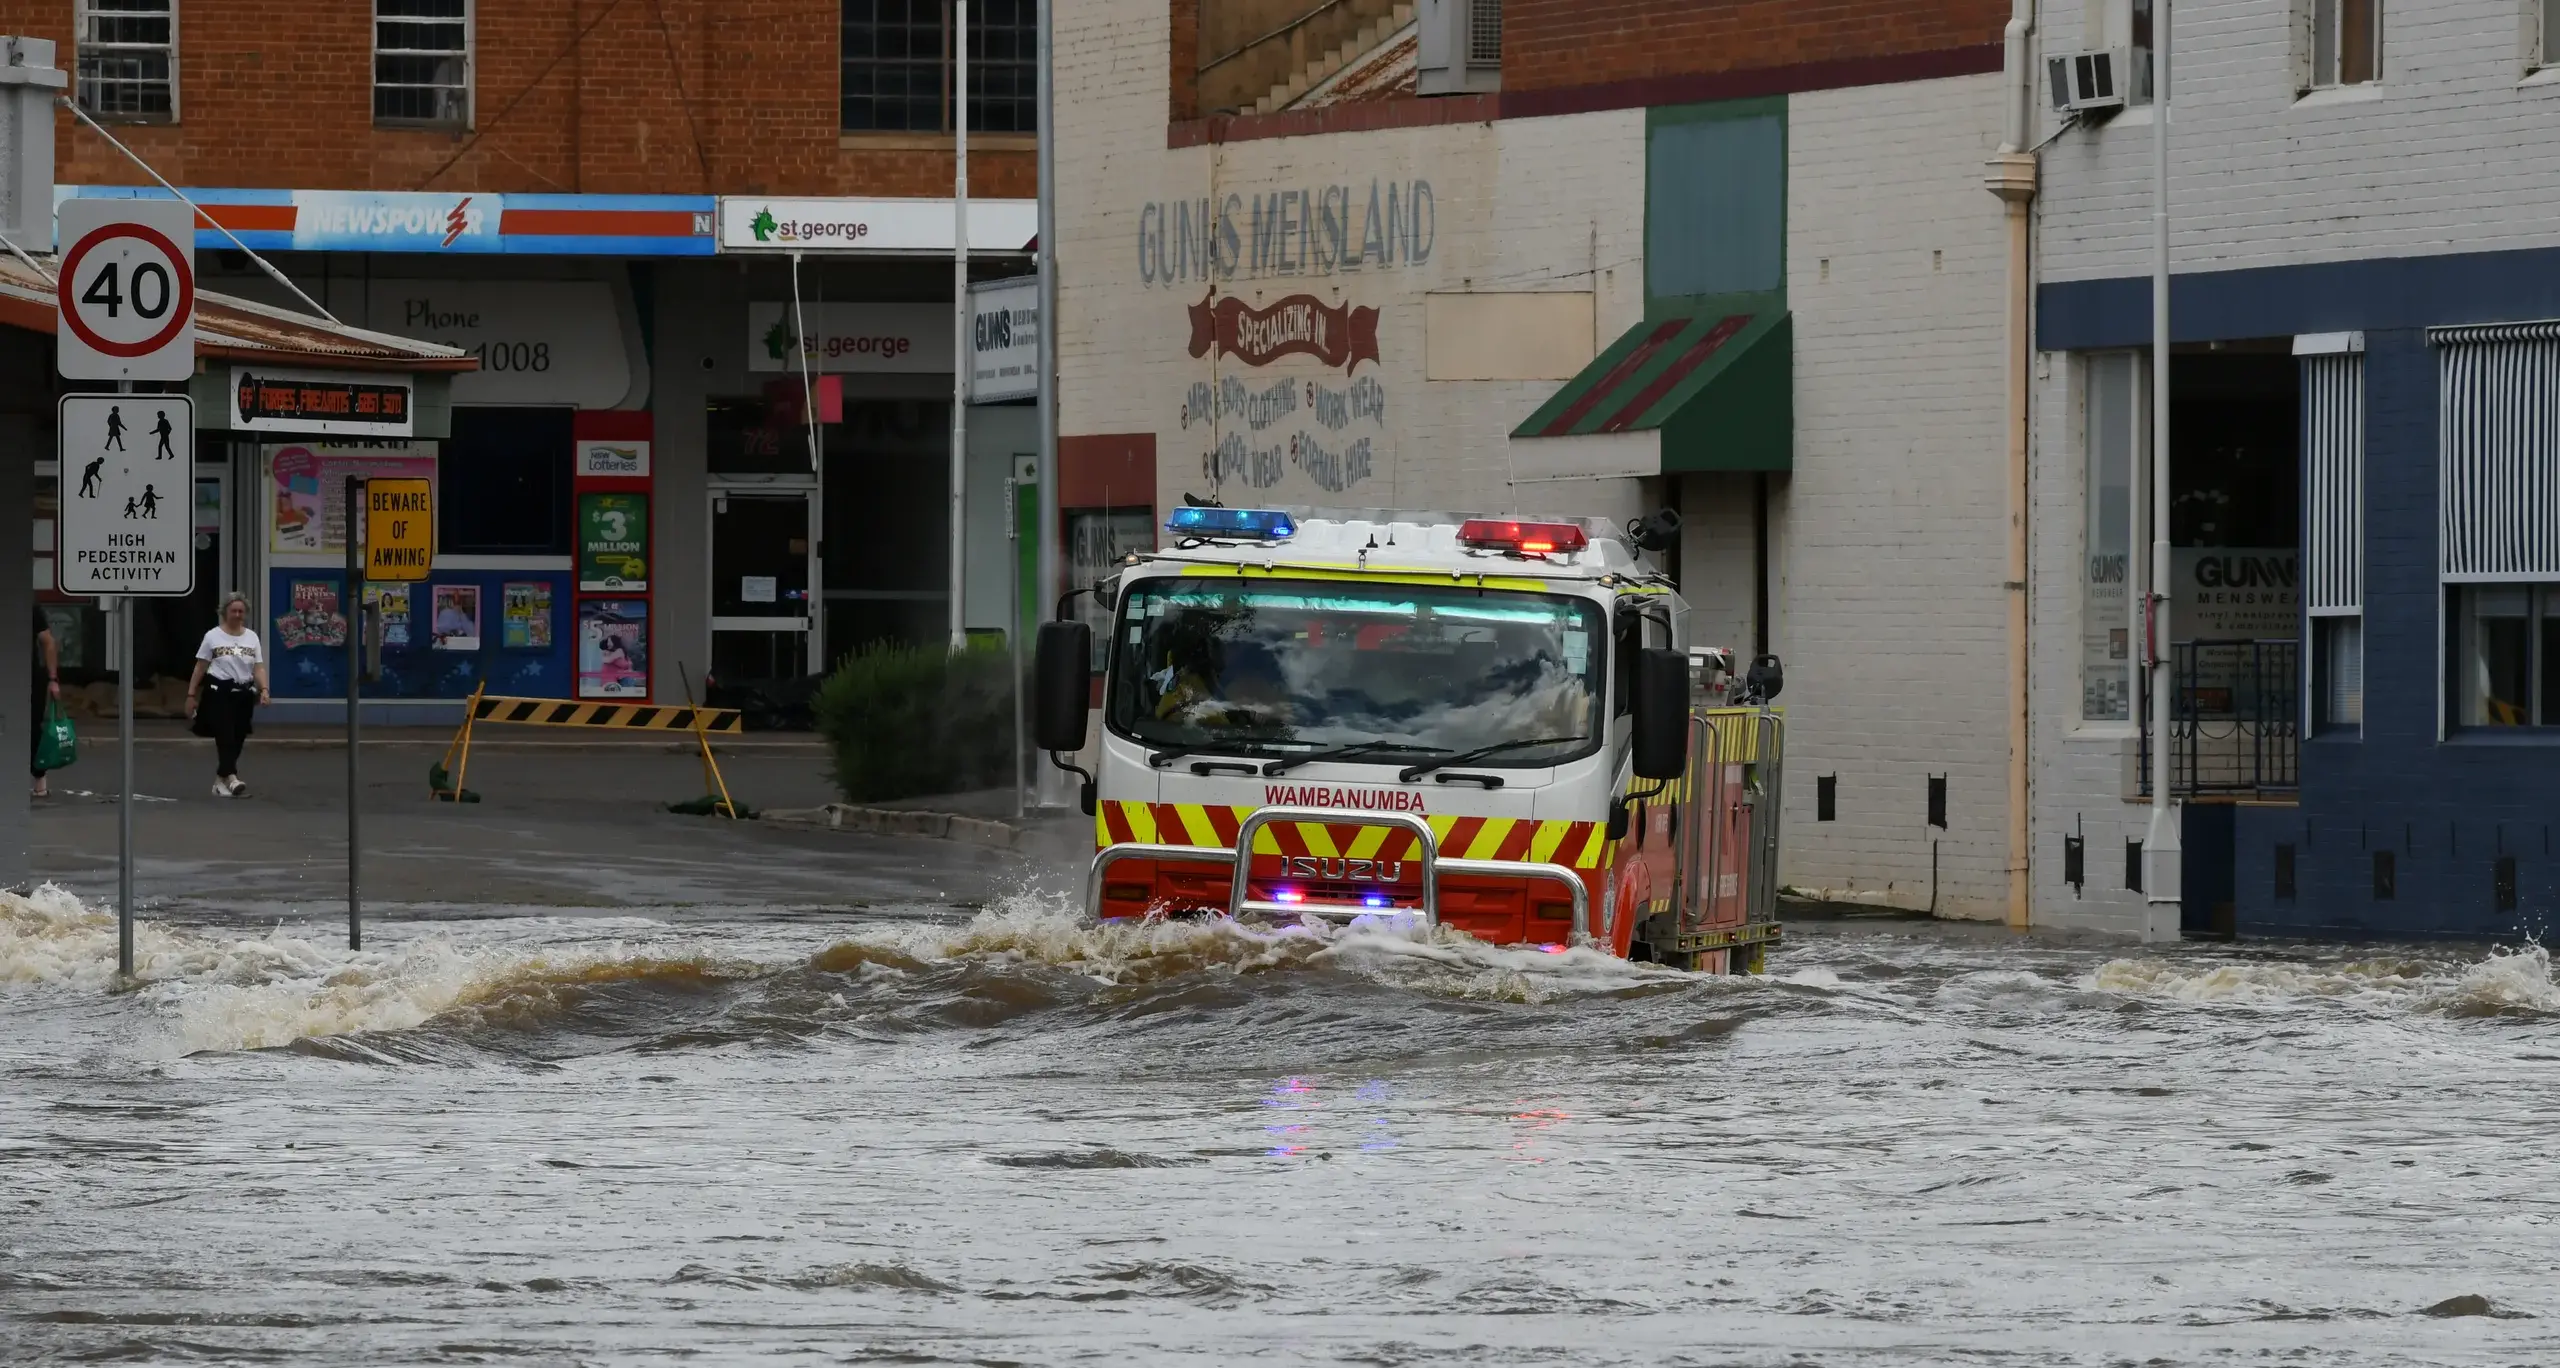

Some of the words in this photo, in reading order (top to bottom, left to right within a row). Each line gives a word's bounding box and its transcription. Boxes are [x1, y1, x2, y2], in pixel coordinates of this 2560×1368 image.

[780, 219, 868, 240] st.george
[1250, 175, 1434, 275] MENSLAND
[82, 262, 170, 319] 40
[404, 298, 481, 330] Phone
[1237, 303, 1311, 356] SPECIALIZING
[1315, 309, 1331, 355] IN
[803, 332, 910, 358] st.george
[259, 388, 295, 411] FORBES
[300, 390, 349, 414] FIREARMS
[1249, 377, 1296, 430] CLOTHING
[1316, 381, 1348, 430] WORK
[1350, 375, 1384, 429] WEAR
[589, 459, 638, 472] Lotteries
[1252, 444, 1284, 488] WEAR
[1299, 429, 1343, 492] FORMAL
[1345, 437, 1371, 488] HIRE
[373, 493, 427, 512] BEWARE
[108, 534, 145, 546] HIGH
[392, 520, 409, 540] OF
[78, 551, 175, 563] PEDESTRIAN
[373, 547, 425, 567] AWNING
[587, 542, 640, 552] MILLION
[91, 567, 162, 580] ACTIVITY
[1264, 784, 1426, 812] WAMBANUMBA
[1279, 855, 1402, 883] ISUZU
